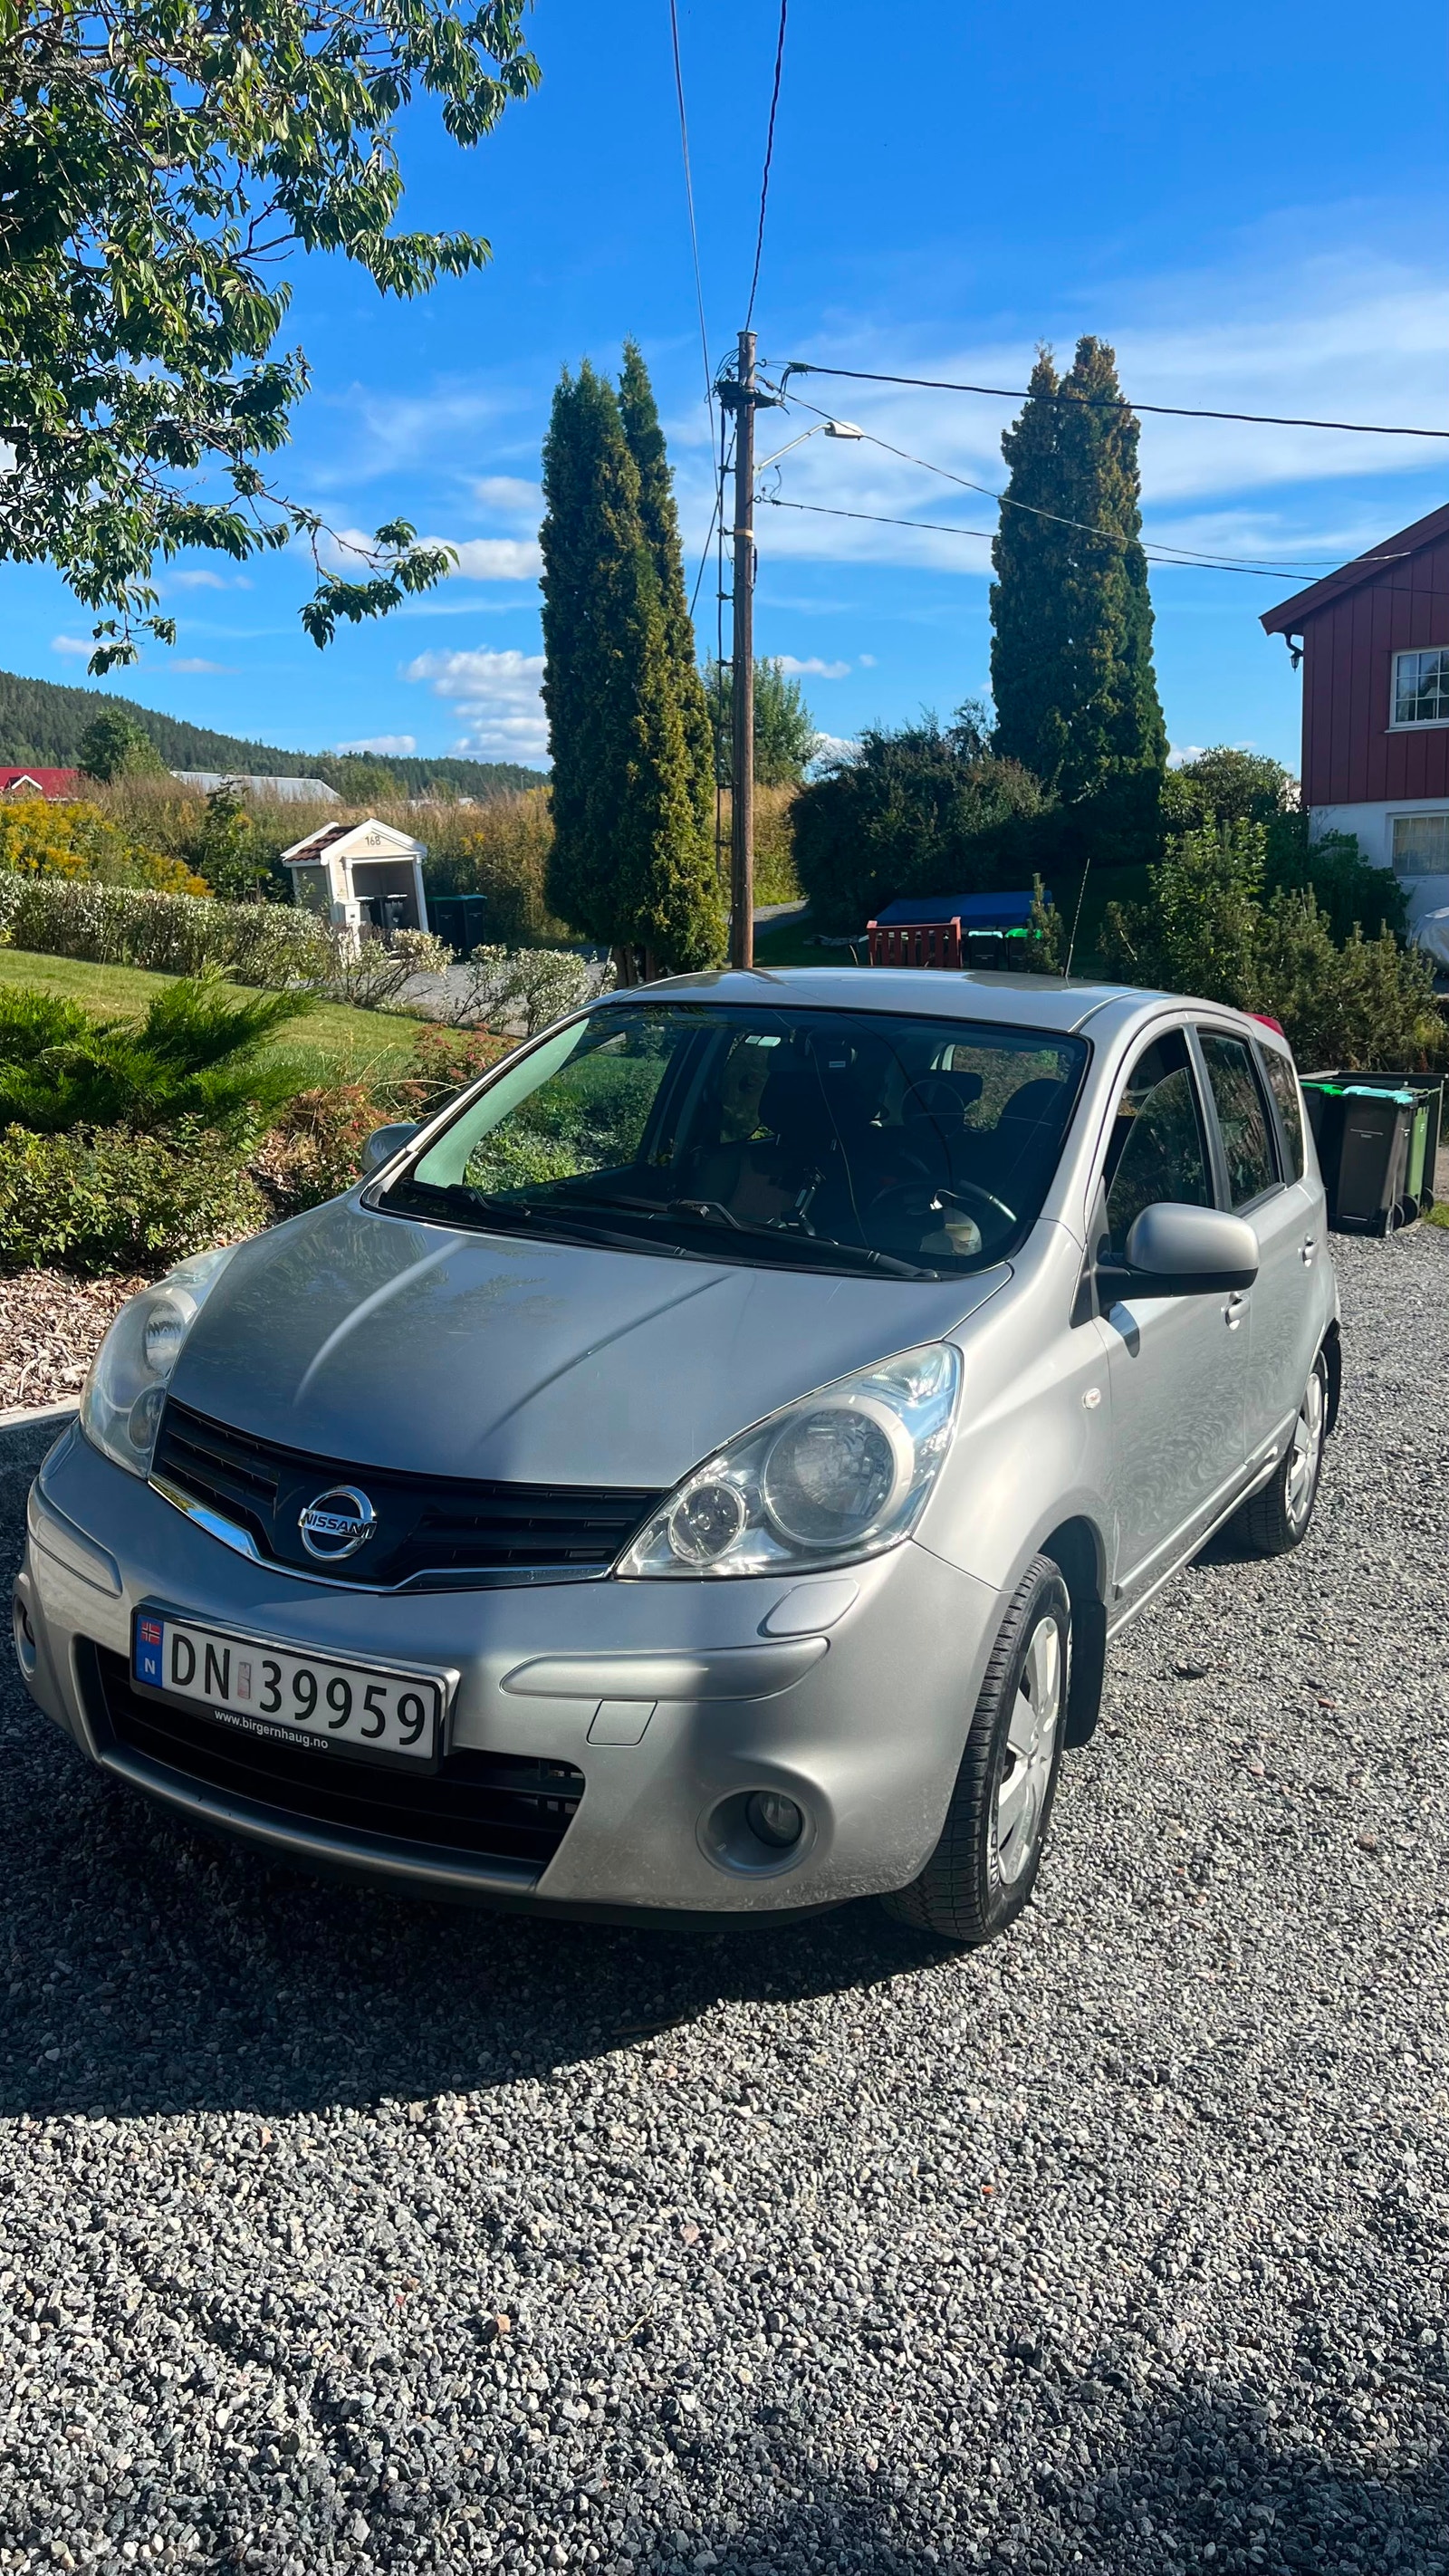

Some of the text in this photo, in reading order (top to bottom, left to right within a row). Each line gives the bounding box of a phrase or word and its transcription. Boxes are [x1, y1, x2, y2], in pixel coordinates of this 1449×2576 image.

[302, 1512, 365, 1535] NISSAN
[144, 1658, 156, 1675] N
[171, 1633, 426, 1745] DN 39959
[215, 1709, 329, 1749] www.birgernhaug.no
